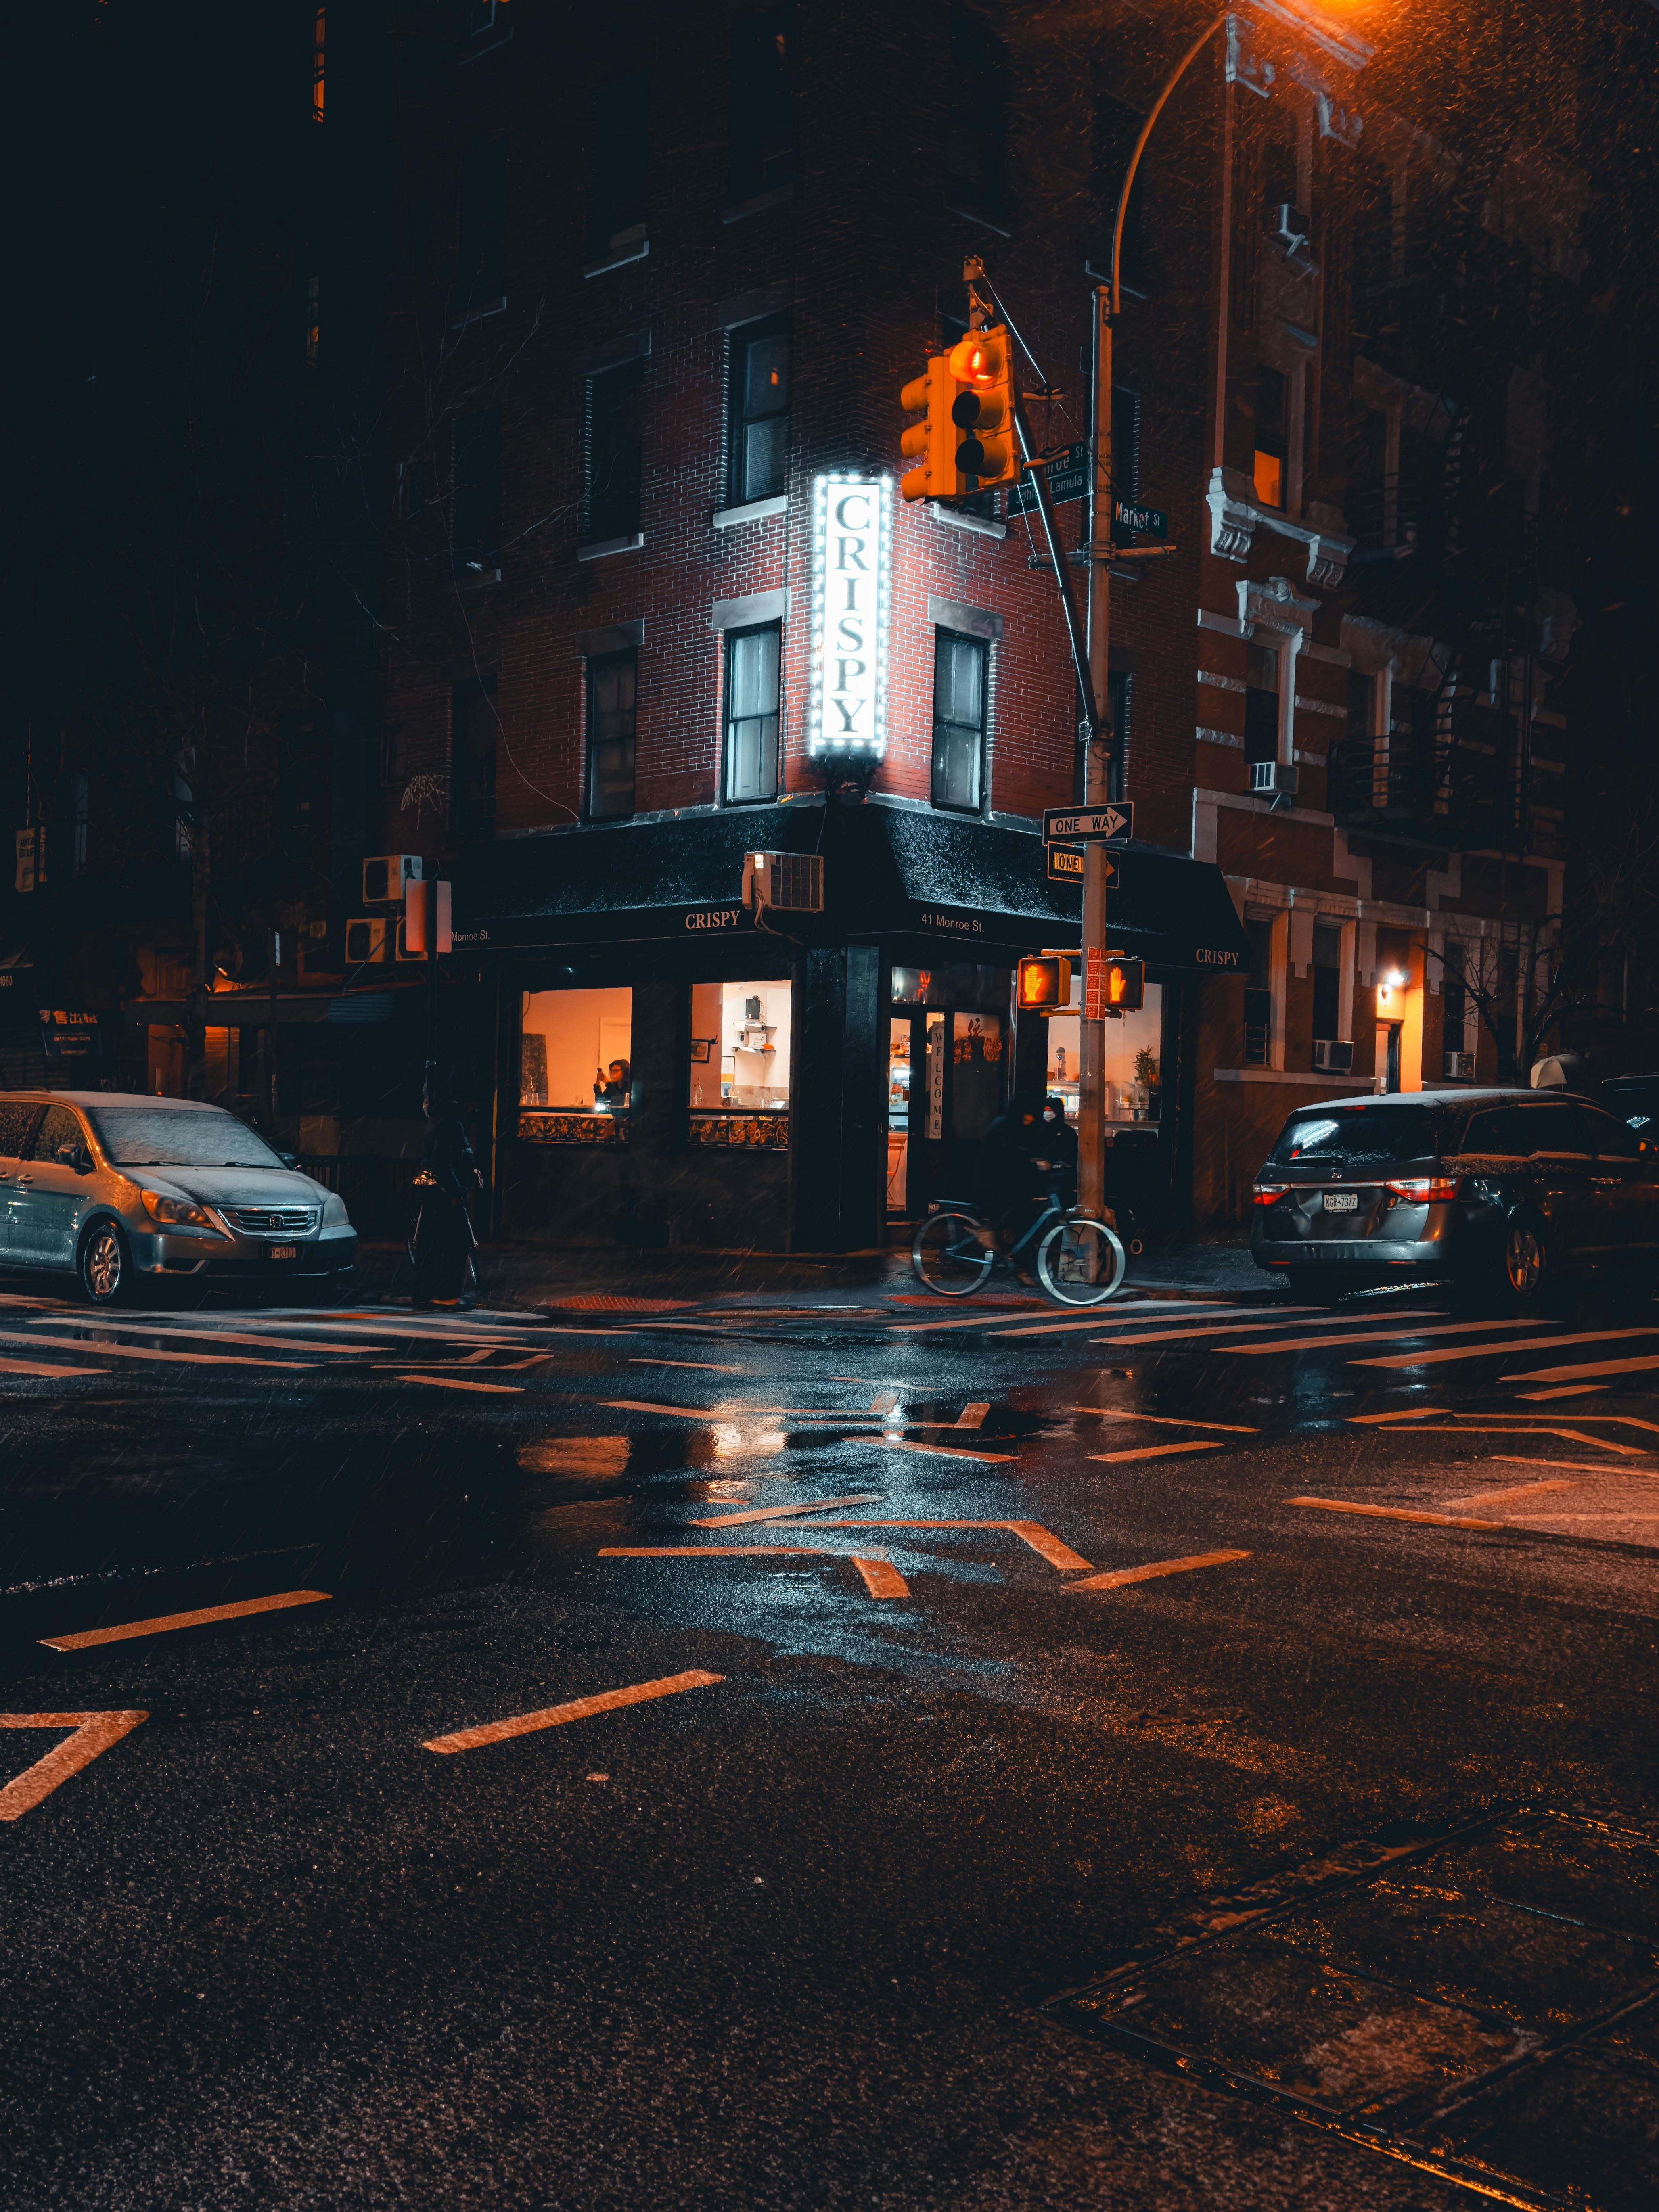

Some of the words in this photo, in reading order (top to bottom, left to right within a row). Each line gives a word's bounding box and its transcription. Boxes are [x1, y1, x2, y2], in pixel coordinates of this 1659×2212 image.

[1075, 445, 1083, 458] St
[1050, 474, 1082, 494] Lamula
[1115, 501, 1149, 529] Market
[1153, 513, 1160, 527] St
[829, 495, 870, 733] CRISPY
[1056, 819, 1080, 833] ONE
[1092, 815, 1118, 830] WAY
[1059, 855, 1079, 871] ONE
[685, 910, 740, 929] CRISPY
[921, 913, 931, 925] 41
[936, 914, 969, 930] Monroe
[972, 920, 984, 932] St.
[452, 931, 478, 941] Monroe
[480, 930, 490, 940] St.
[1195, 949, 1239, 966] CRISPY
[933, 1033, 942, 1129] WELCOME
